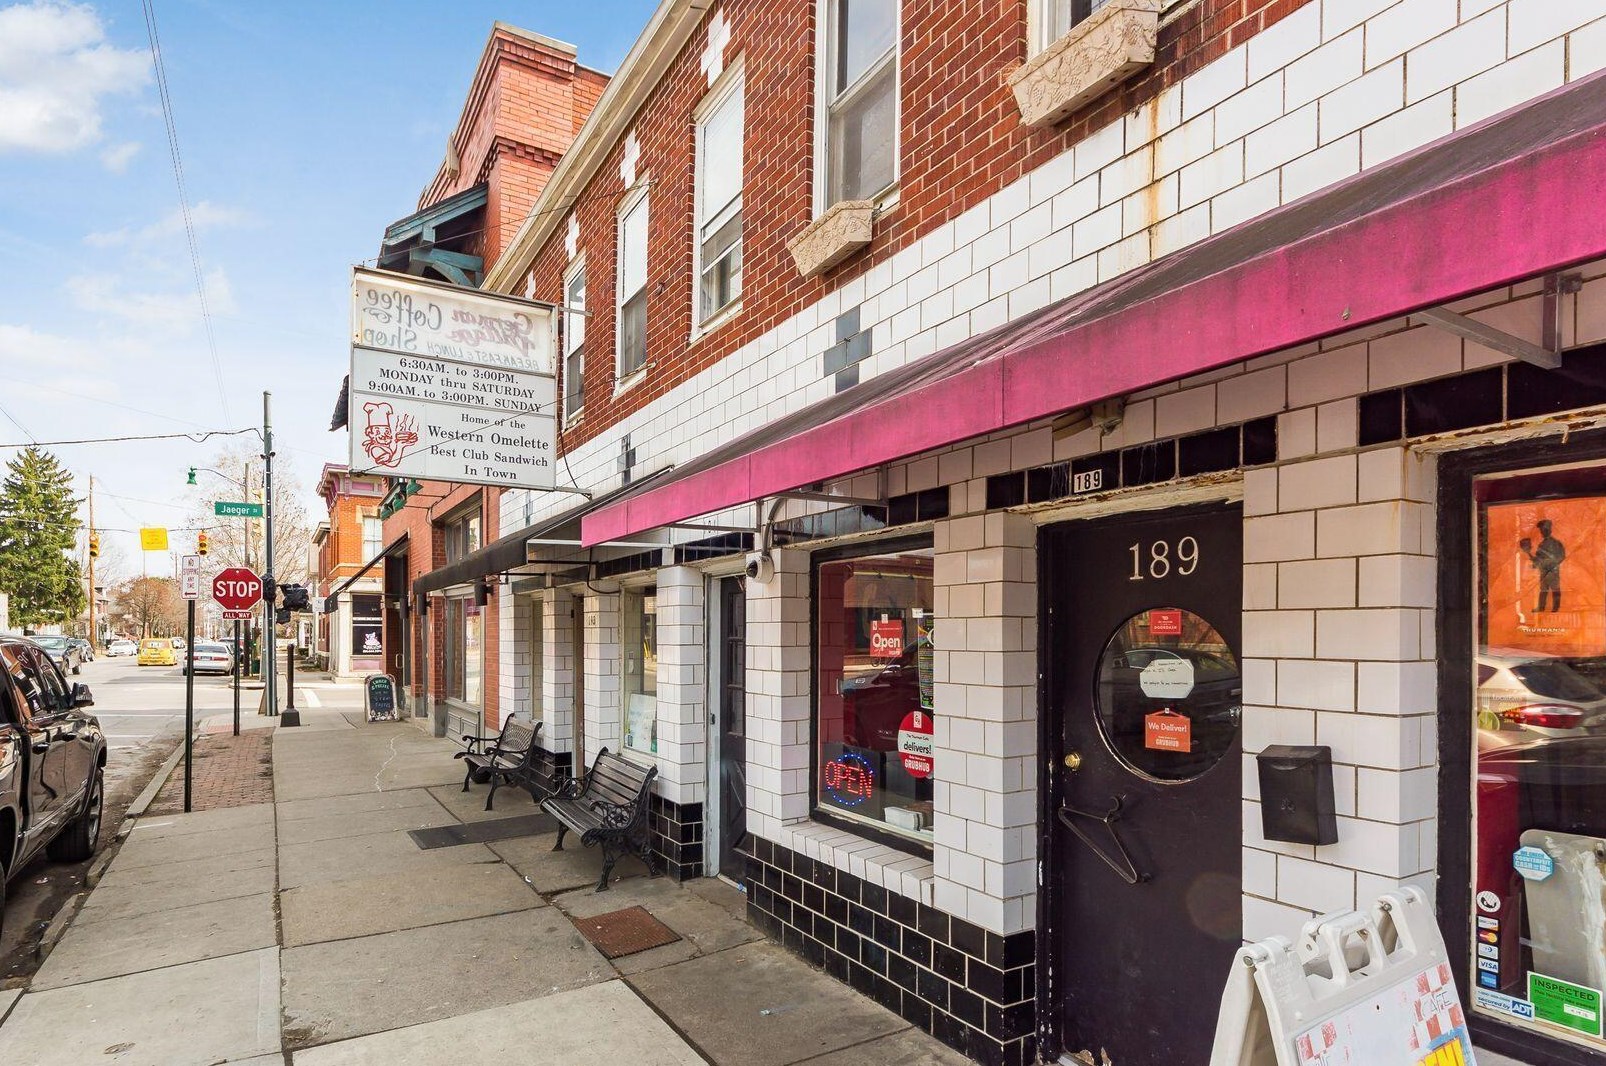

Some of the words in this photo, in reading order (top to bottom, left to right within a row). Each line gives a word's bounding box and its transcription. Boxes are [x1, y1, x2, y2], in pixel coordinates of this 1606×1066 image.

[399, 358, 450, 374] 6:30AM.
[456, 366, 467, 376] to
[472, 369, 519, 385] 3:00PM.
[379, 368, 434, 385] MONDAY
[440, 378, 467, 389] thru
[472, 382, 535, 399] SATURDAY
[368, 381, 420, 397] 9:00AM.
[424, 388, 436, 398] to
[441, 391, 489, 406] 3:00PM.
[494, 399, 542, 413] SUNDAY
[461, 413, 490, 425] Home
[494, 417, 505, 426] of
[510, 418, 526, 429] the
[428, 425, 484, 443] Western
[491, 432, 549, 450] Omelette
[430, 444, 457, 458] Best
[462, 449, 489, 461] Club
[494, 452, 548, 467] Sandwich
[464, 464, 478, 476] In
[484, 467, 517, 480] Town
[1075, 471, 1100, 491] 189
[220, 505, 250, 515] Jaeger
[1129, 536, 1199, 580] 189
[215, 581, 260, 598] STOP
[872, 633, 900, 651] Open
[1148, 722, 1160, 730] We
[1161, 723, 1187, 733] Deliver!
[903, 741, 932, 755] delivers!
[904, 758, 930, 773] GRUBHUB
[825, 761, 872, 799] OPEN
[1480, 961, 1498, 970] VISA
[1534, 979, 1595, 1001] INSPECTED
[1477, 996, 1502, 1007] secured
[1512, 1003, 1532, 1016] ADT
